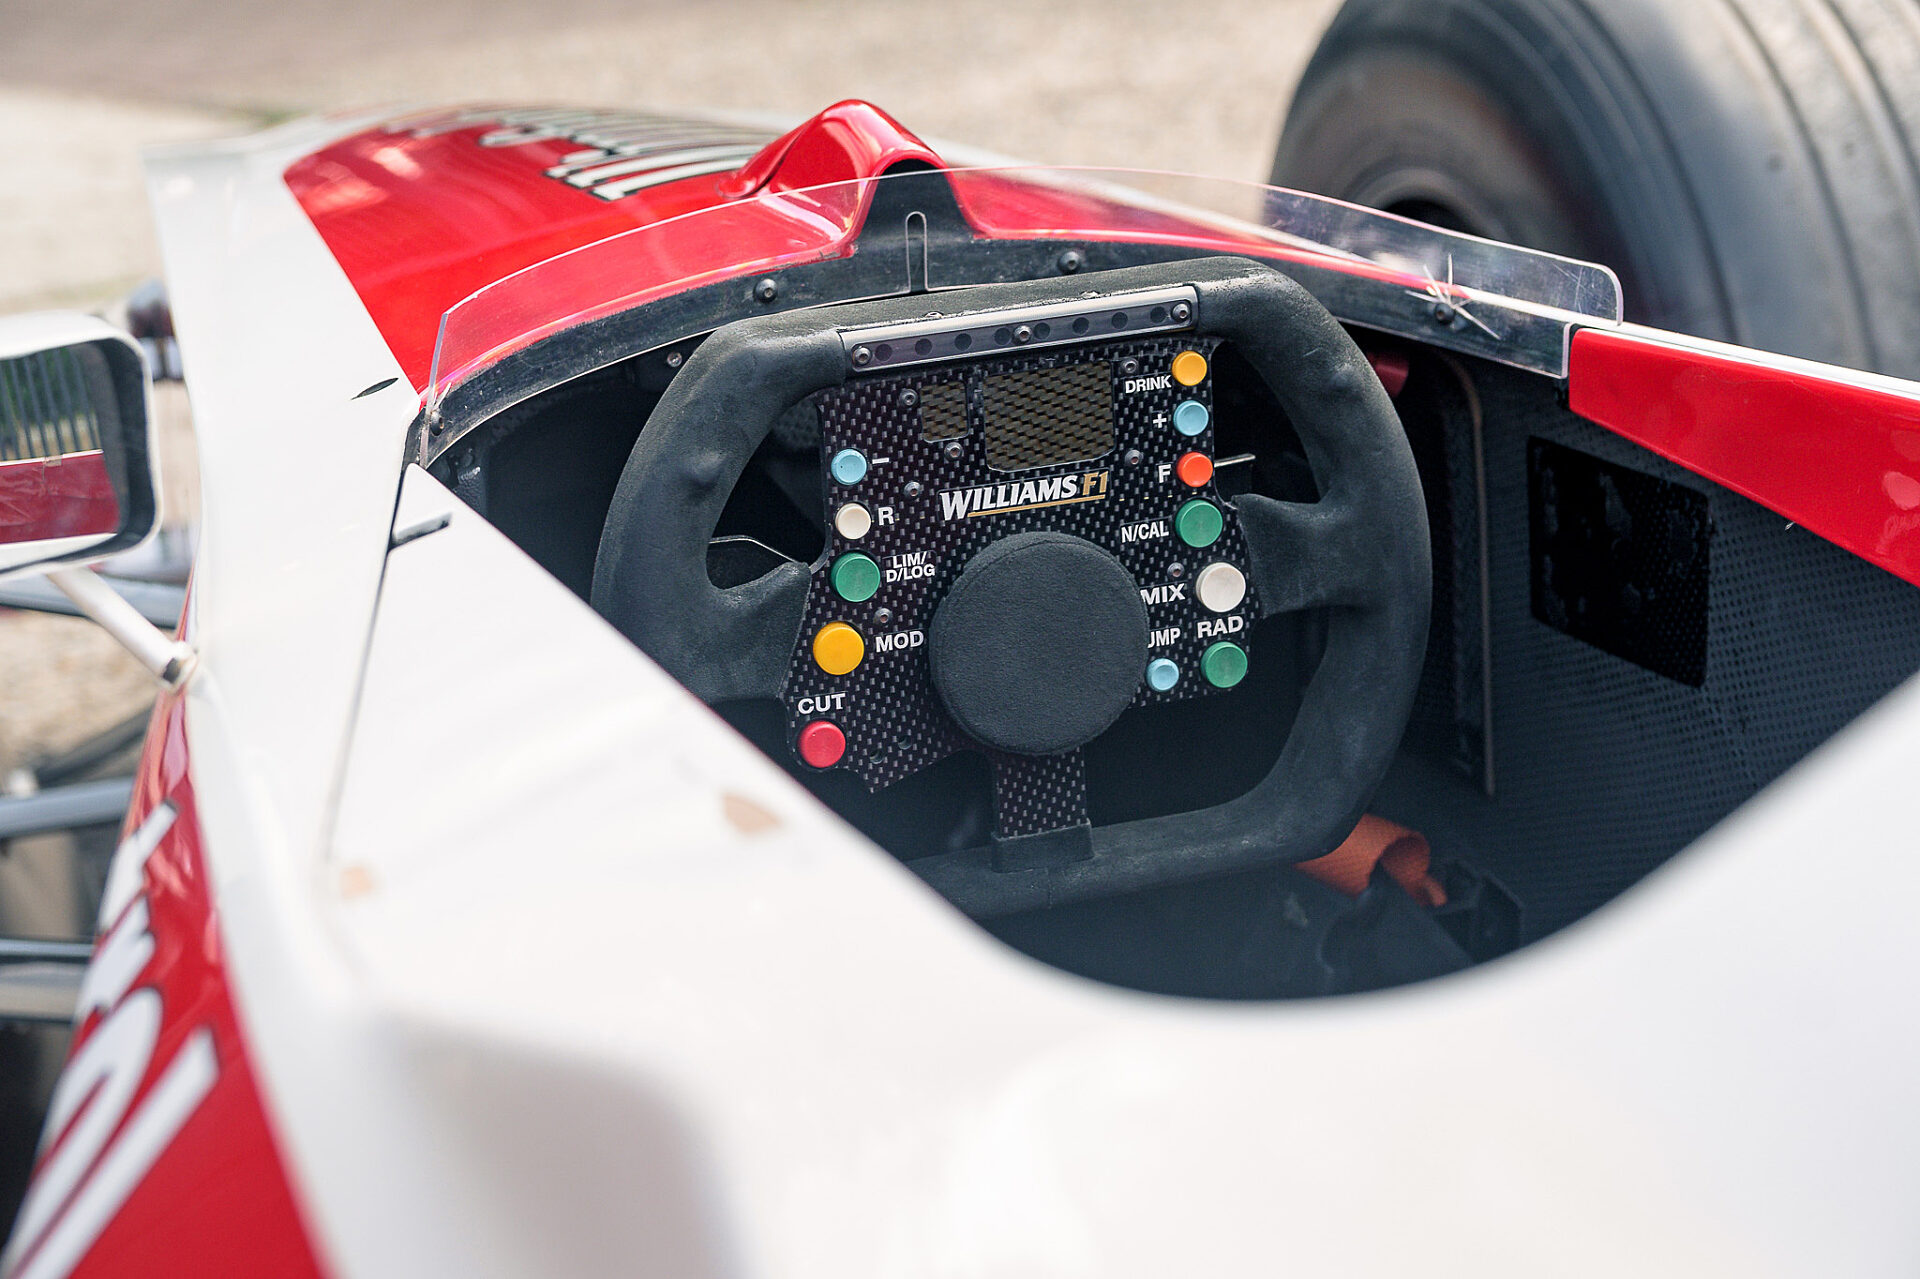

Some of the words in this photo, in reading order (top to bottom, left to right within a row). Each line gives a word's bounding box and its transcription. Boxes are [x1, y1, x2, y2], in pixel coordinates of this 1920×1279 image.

[1125, 374, 1172, 394] DRINK
[1158, 463, 1172, 484] F
[939, 474, 1078, 521] WILLIAMS
[1082, 470, 1109, 496] F1
[878, 506, 895, 526] R
[1121, 520, 1170, 543] N/CAL
[892, 551, 928, 569] LIM/
[886, 563, 936, 583] D/LOG
[1140, 582, 1186, 606] MIX
[1147, 627, 1181, 649] JMP
[1197, 615, 1244, 639] RAD
[875, 630, 925, 653] MOD
[797, 692, 846, 715] CUT
